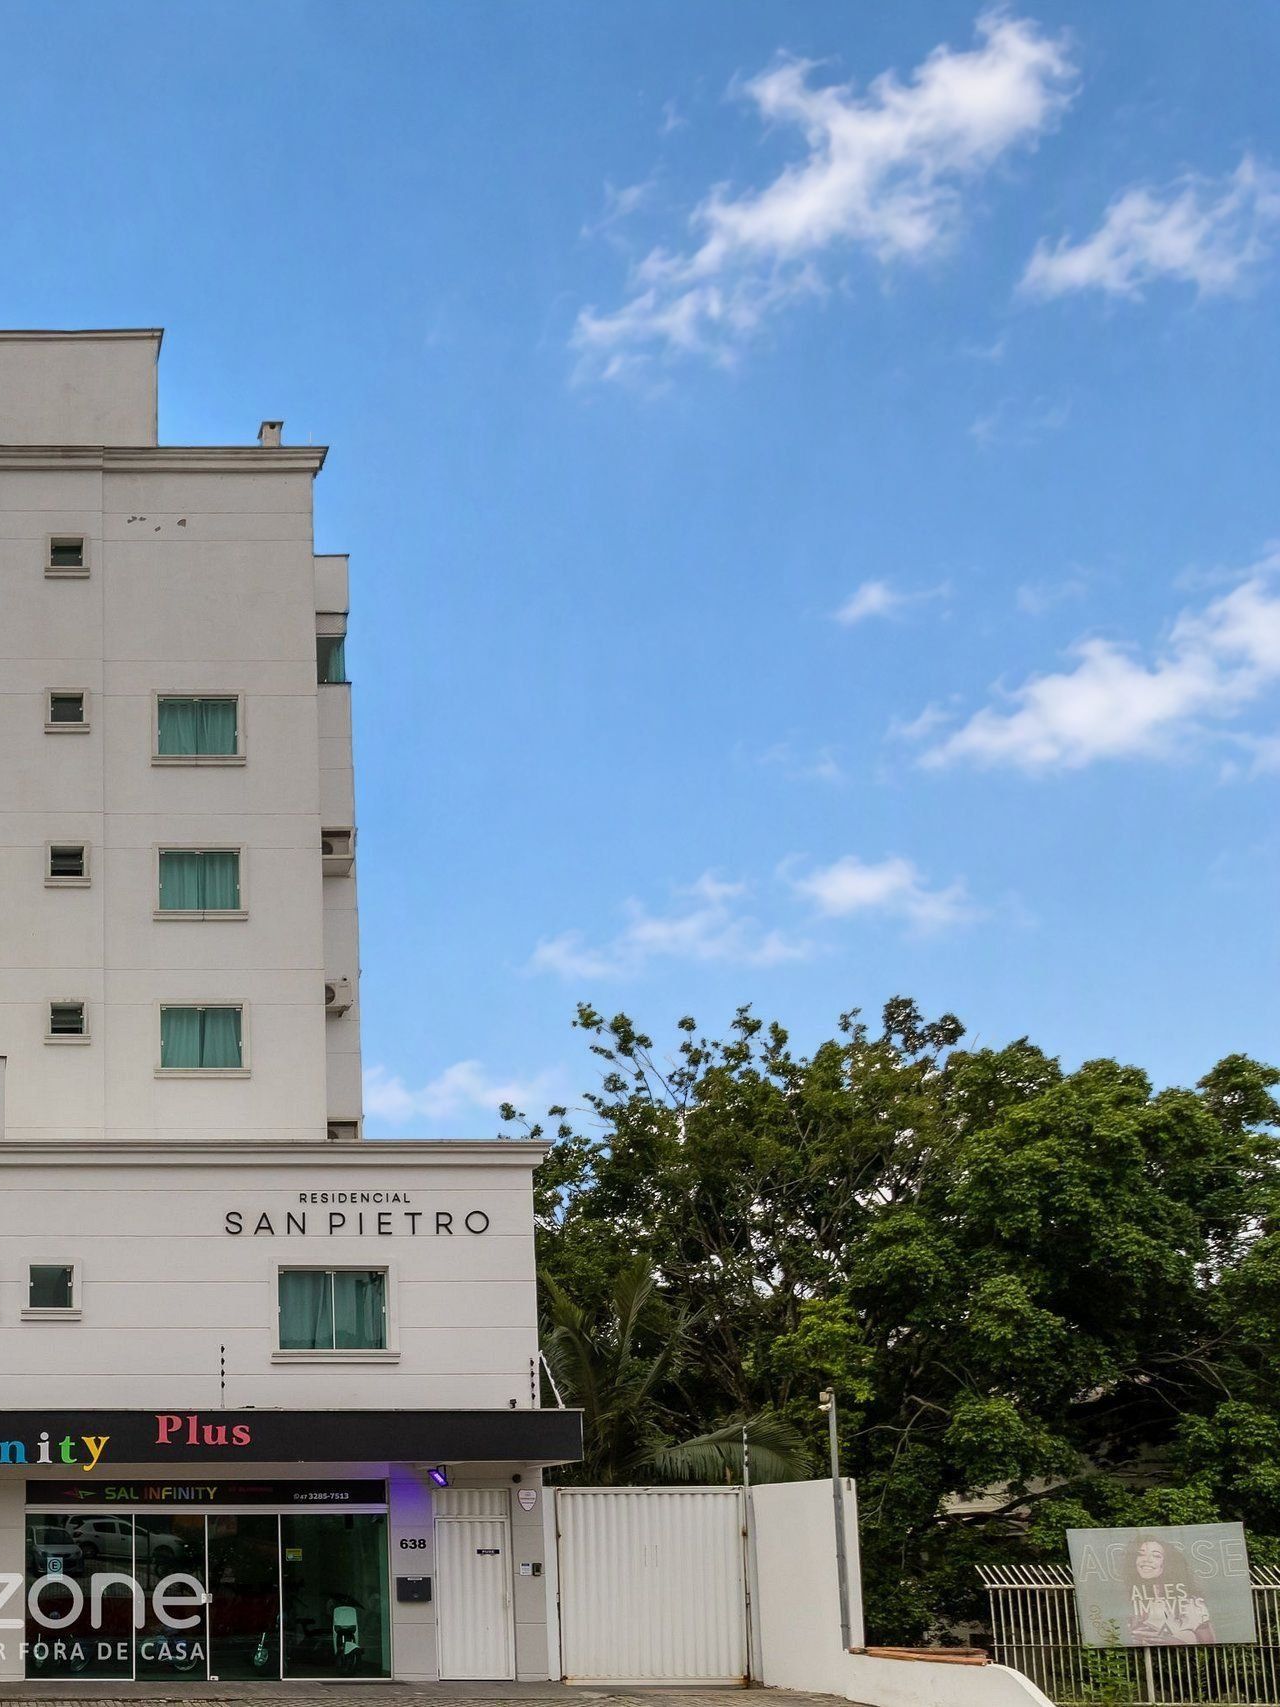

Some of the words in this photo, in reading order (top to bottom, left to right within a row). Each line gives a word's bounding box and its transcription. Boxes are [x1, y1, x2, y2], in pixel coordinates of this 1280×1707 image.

[299, 1192, 411, 1203] RESIDENCIAL
[224, 1211, 306, 1235] SAN
[328, 1210, 490, 1235] PIETRO
[154, 1414, 252, 1446] Plus
[104, 1487, 139, 1500] SAL
[143, 1487, 218, 1500] INFINITY
[399, 1538, 427, 1549] 638
[1131, 1583, 1188, 1601] ALLES
